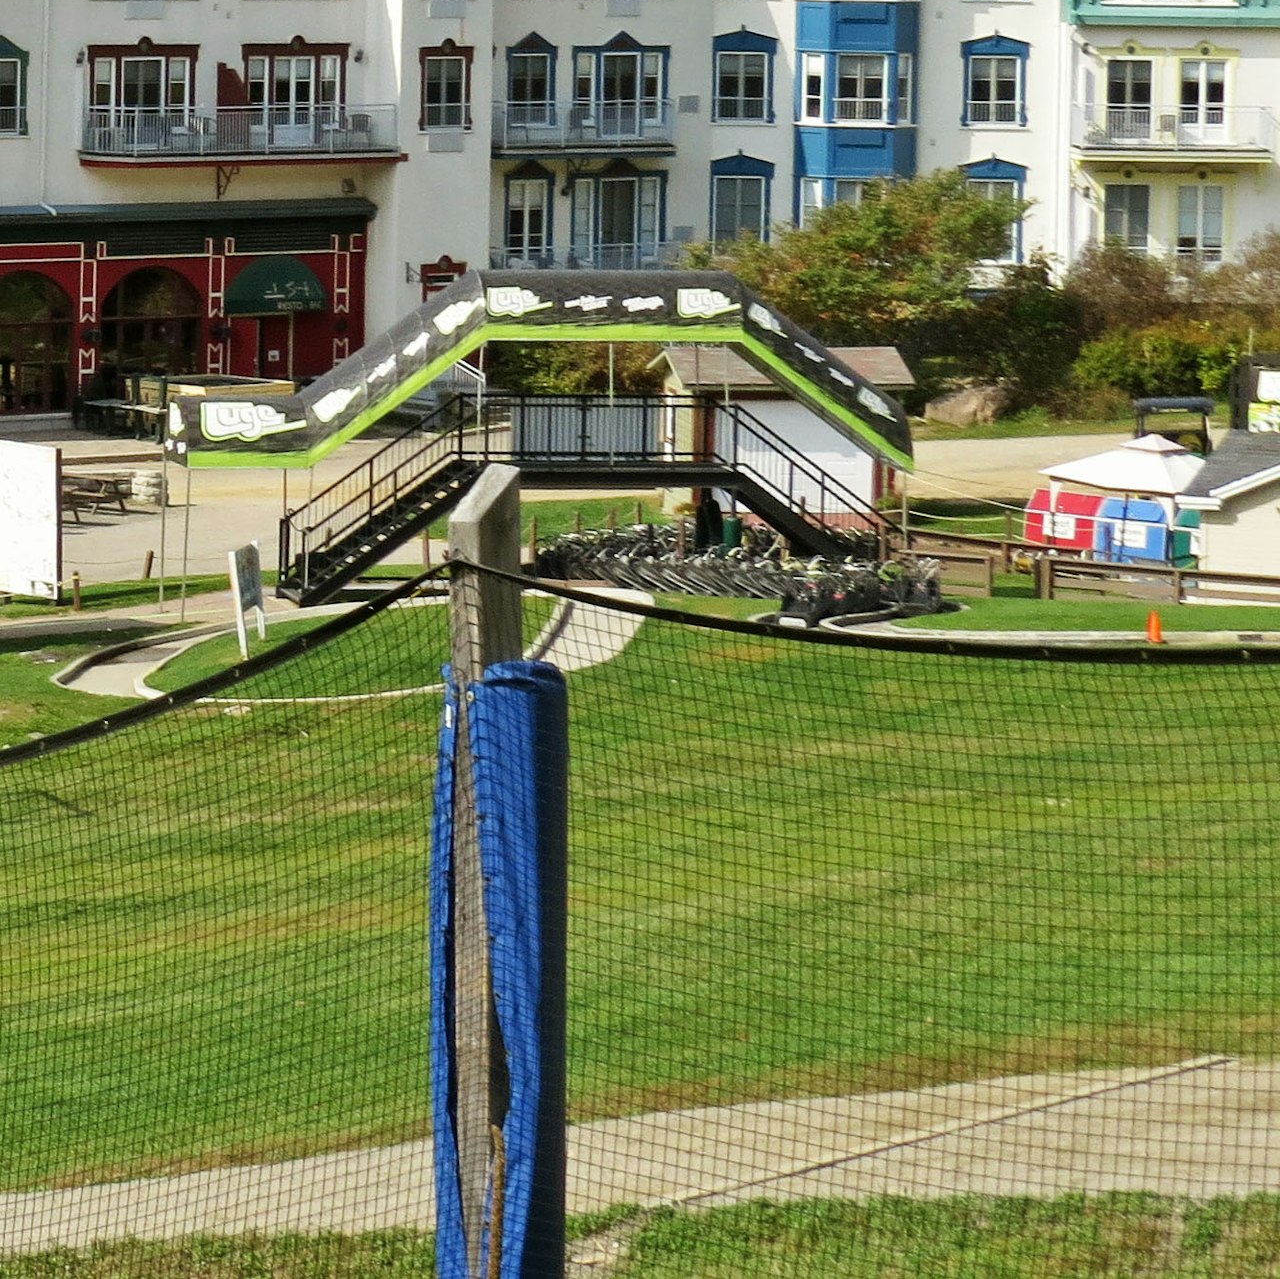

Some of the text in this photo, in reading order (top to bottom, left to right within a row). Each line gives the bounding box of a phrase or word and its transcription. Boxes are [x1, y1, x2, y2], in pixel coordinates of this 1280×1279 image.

[487, 287, 541, 317] Luge
[678, 288, 732, 318] Luge
[201, 402, 289, 441] Luge
